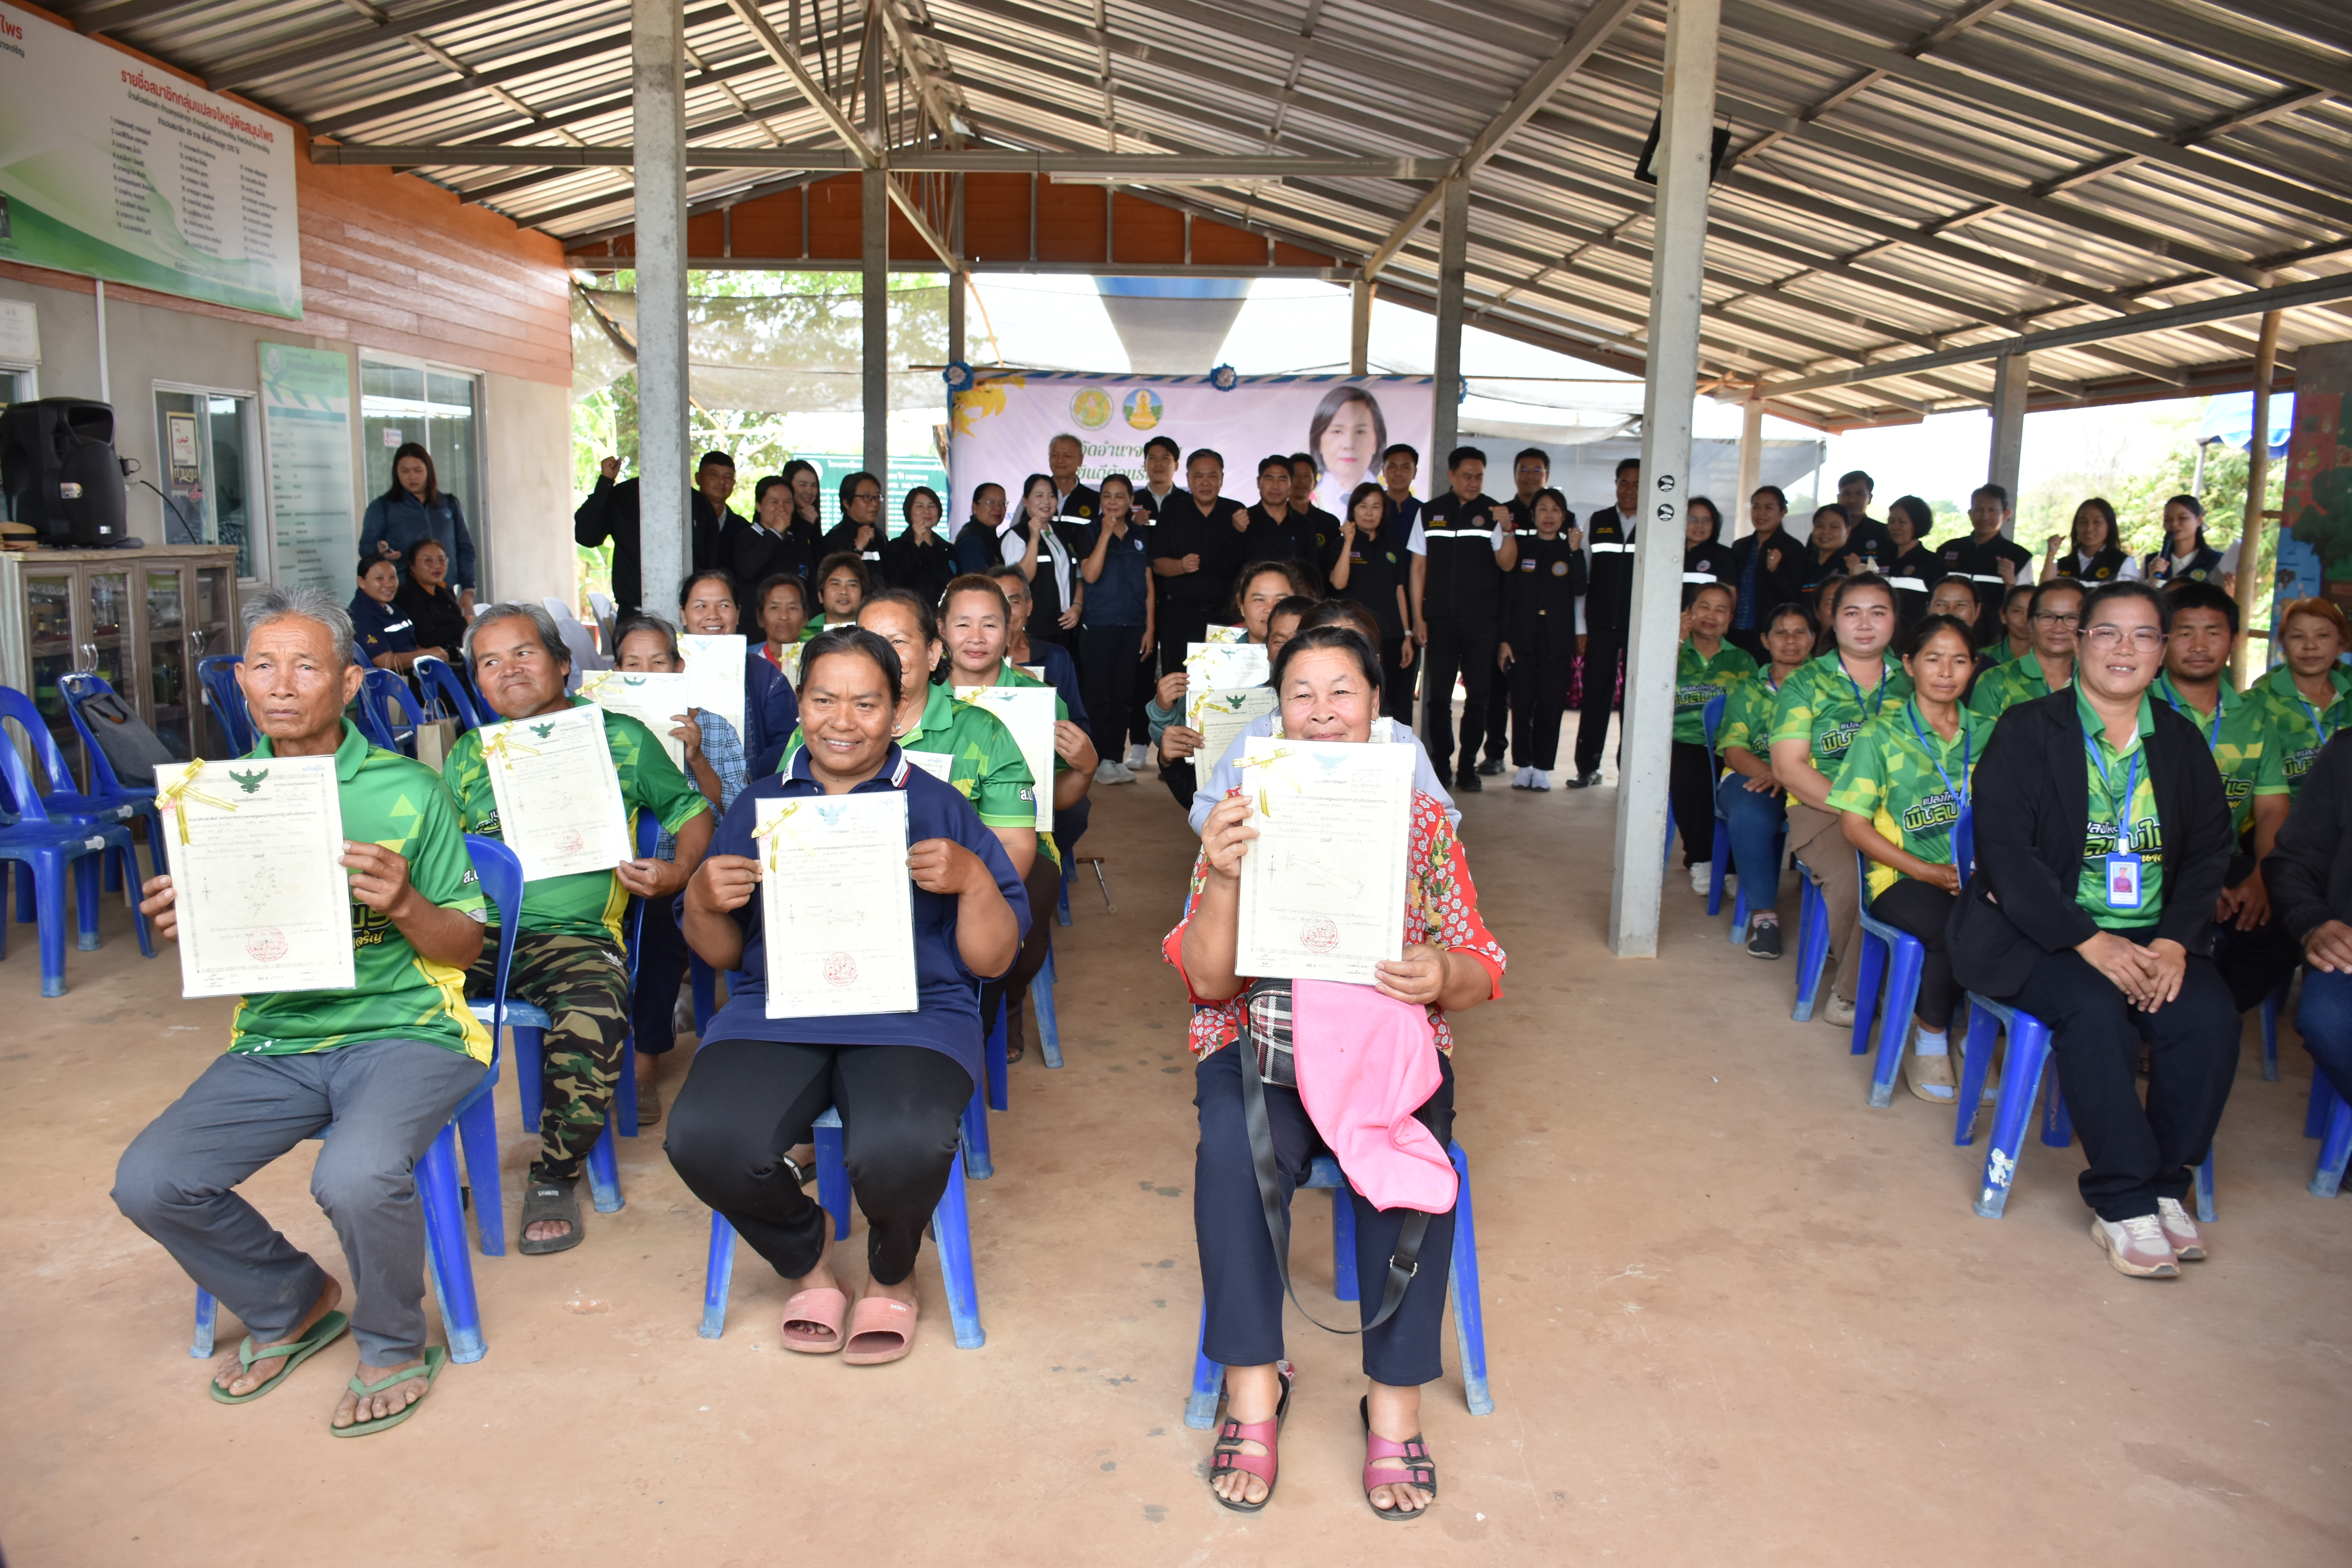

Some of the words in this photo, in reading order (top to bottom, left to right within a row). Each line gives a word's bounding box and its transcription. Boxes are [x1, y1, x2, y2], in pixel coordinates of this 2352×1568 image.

[121, 70, 274, 143] รายชื่อสมาชิกกลุ่มแปลงใหญ่พืชสมุนไพร
